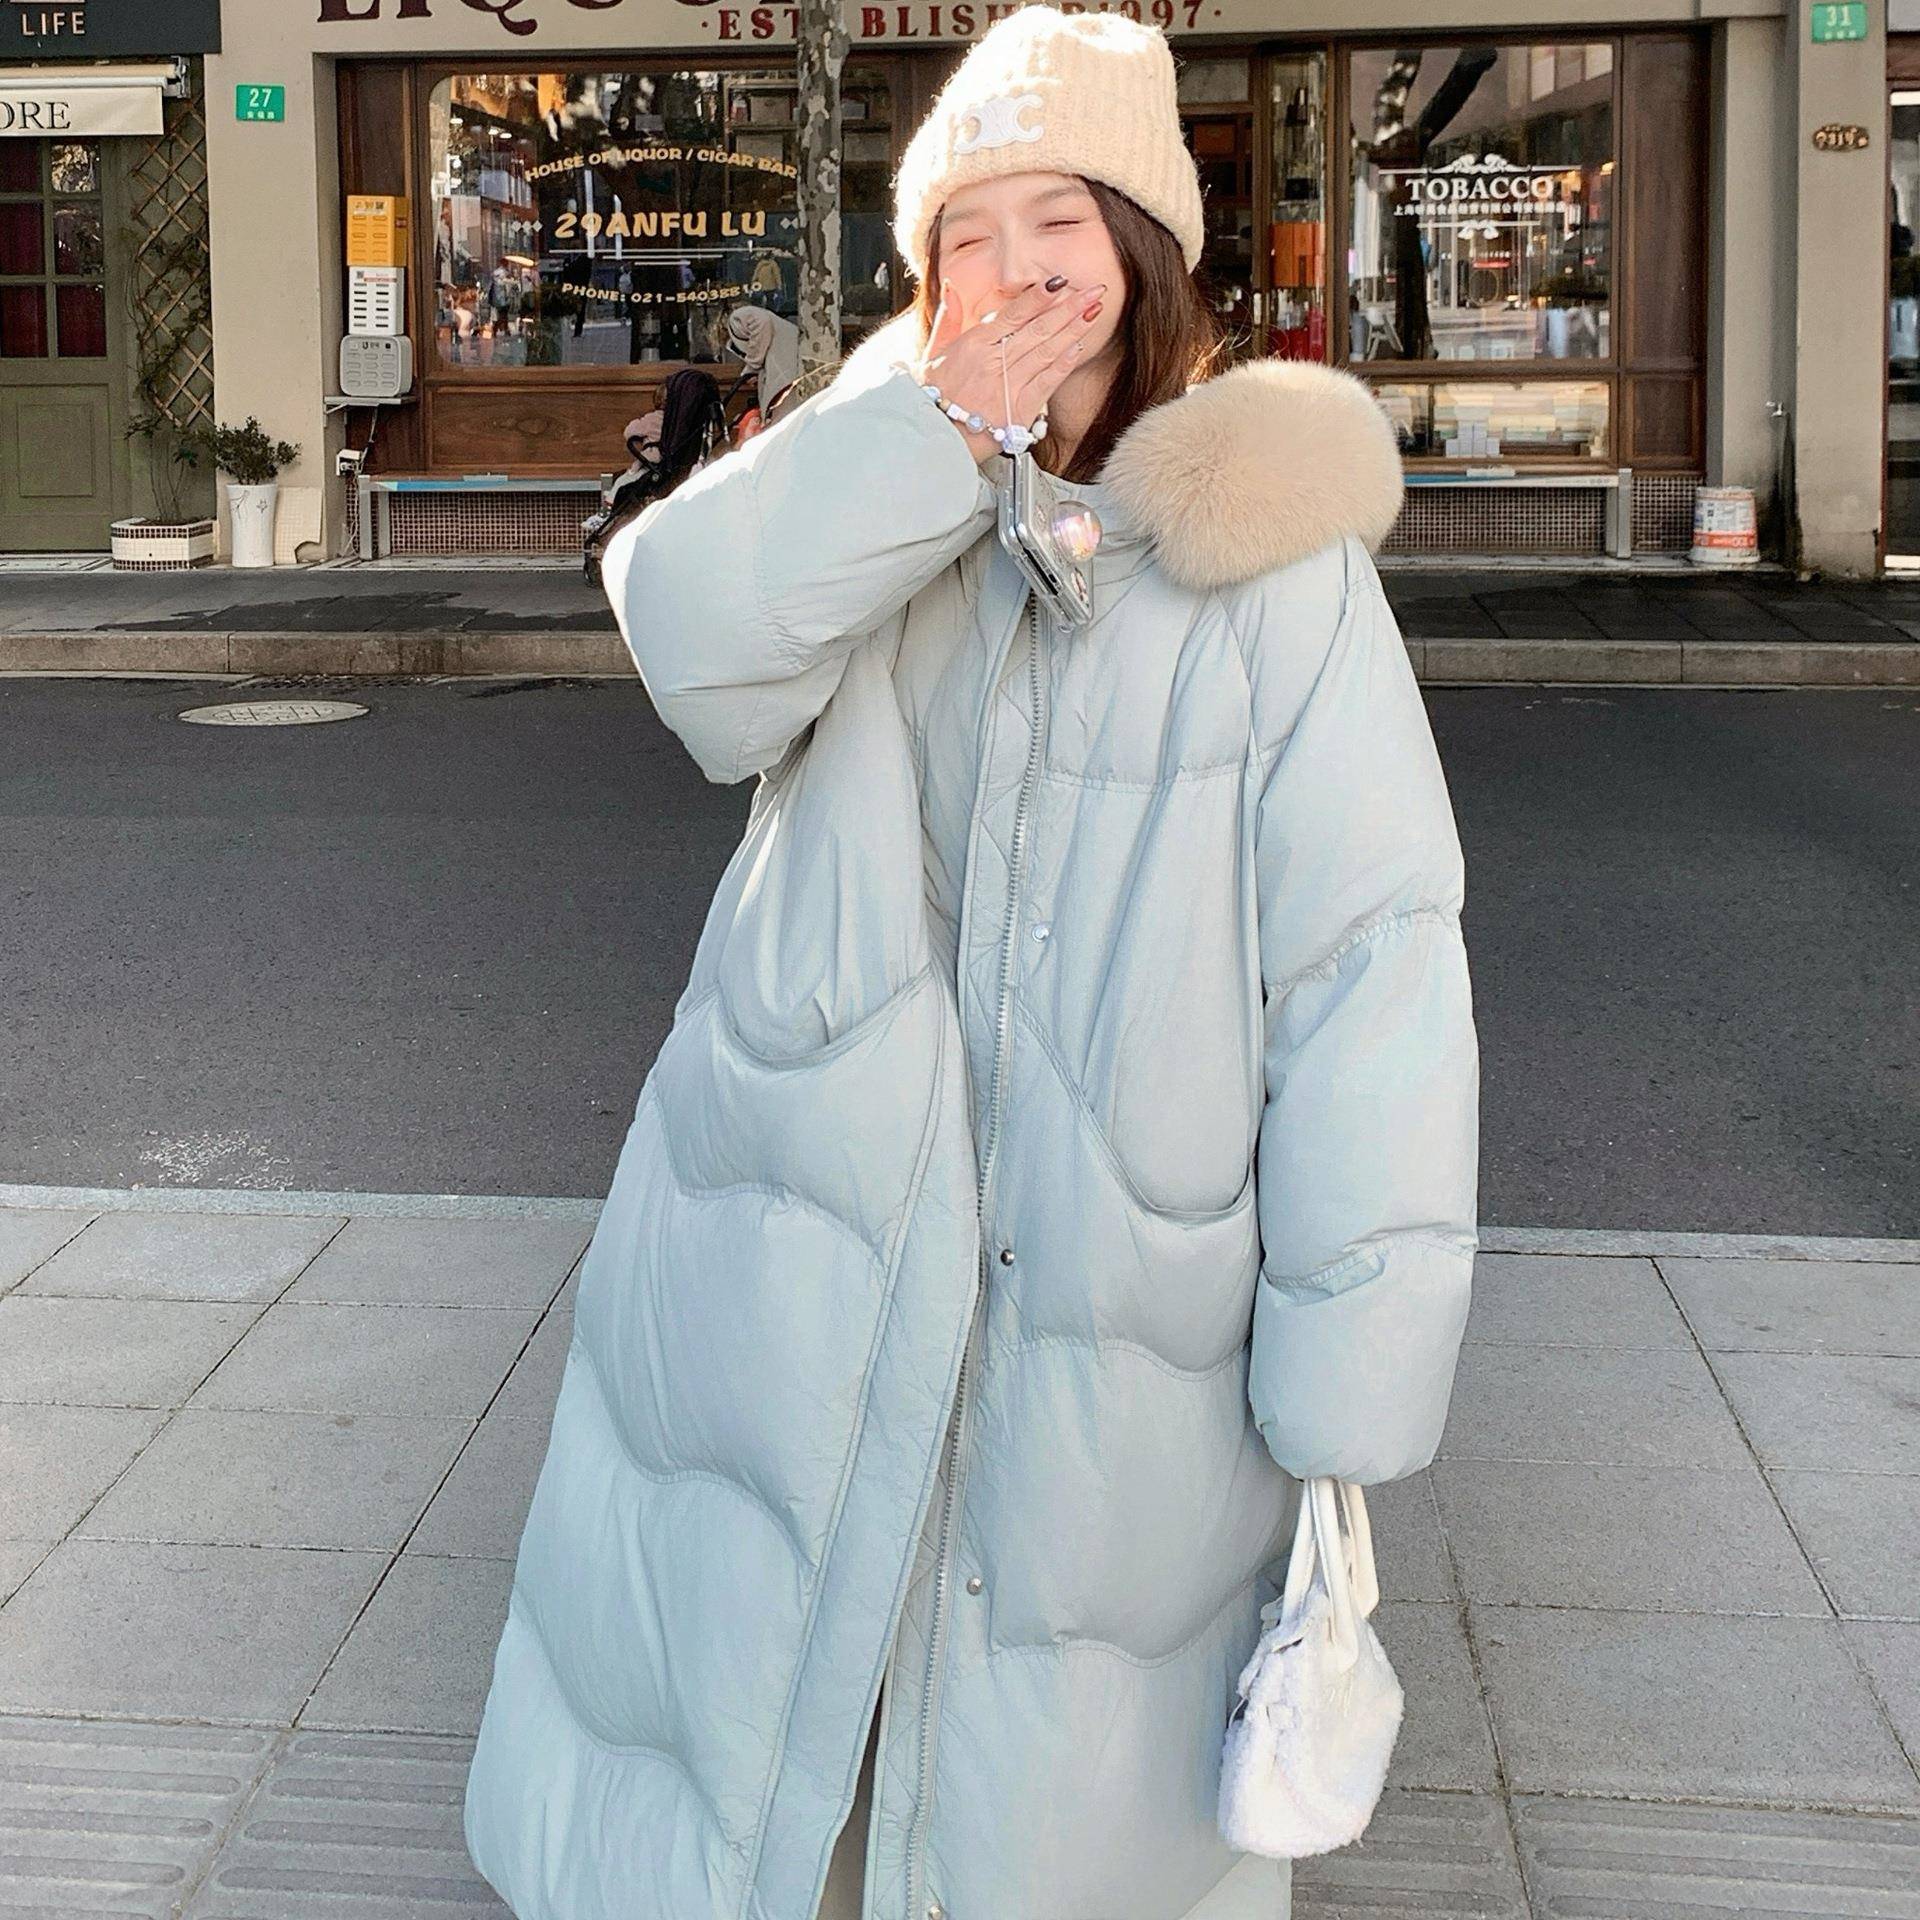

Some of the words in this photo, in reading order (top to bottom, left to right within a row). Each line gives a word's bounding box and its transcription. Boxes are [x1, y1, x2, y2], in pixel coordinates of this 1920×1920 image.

[22, 12, 85, 35] LIFE
[1826, 5, 1852, 26] 31
[249, 87, 272, 107] 27
[524, 154, 585, 182] HOUSE
[617, 147, 682, 162] LIQUOR
[697, 149, 754, 168] CIGAR
[758, 157, 798, 179] BAR
[1404, 175, 1554, 201] TOBACCO
[720, 210, 766, 237] LU
[561, 282, 626, 302] PHONE:
